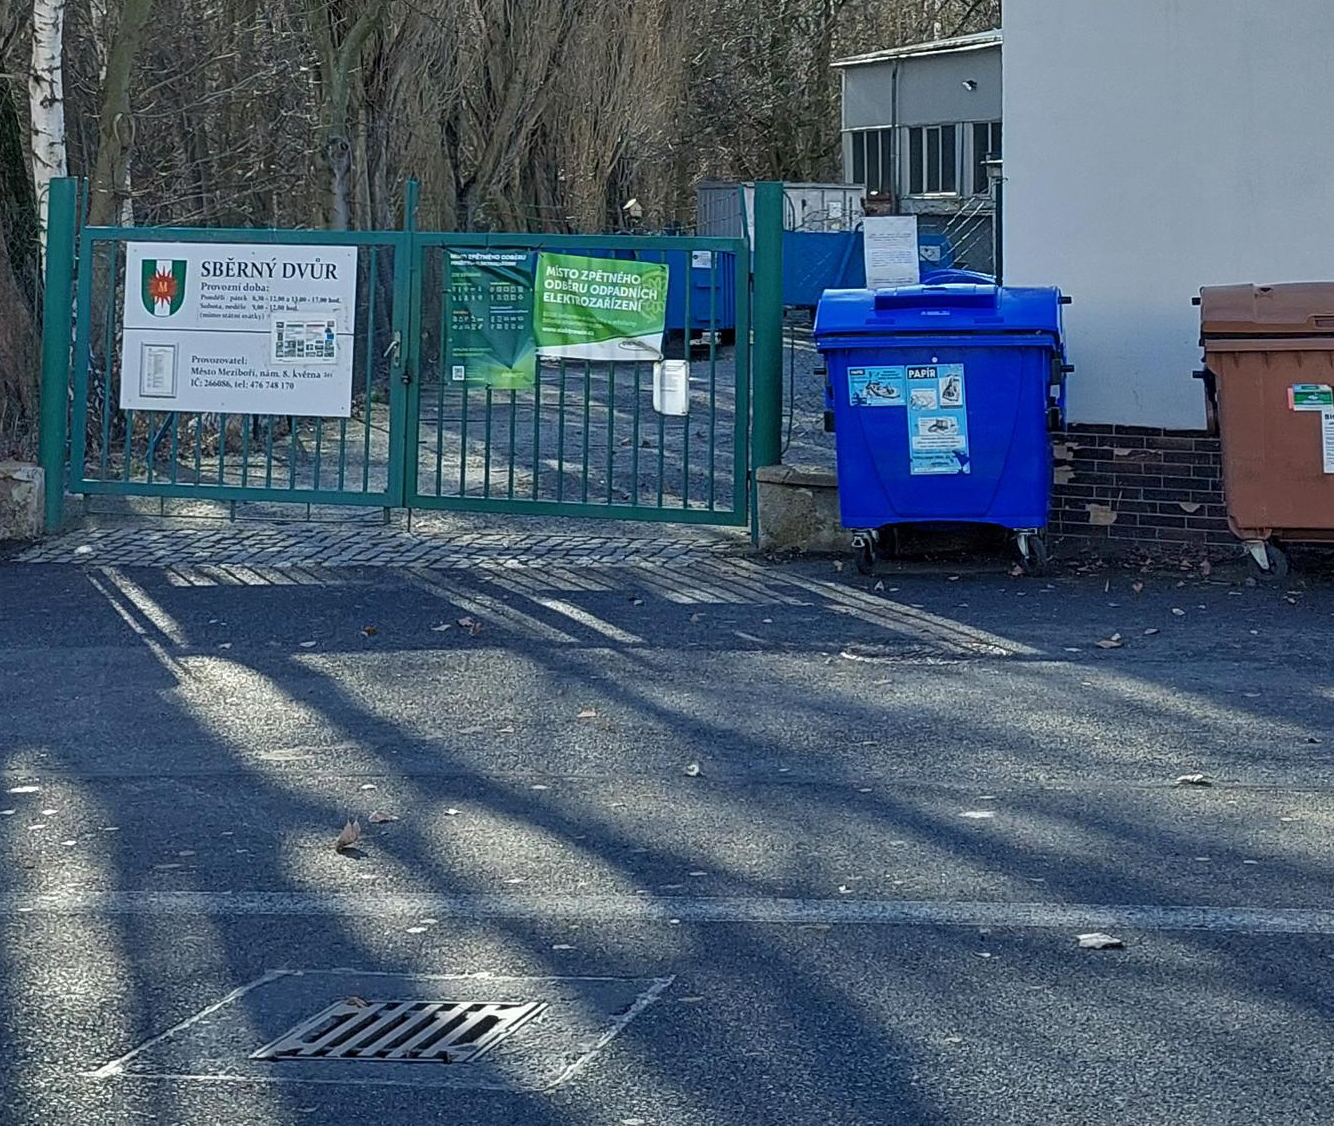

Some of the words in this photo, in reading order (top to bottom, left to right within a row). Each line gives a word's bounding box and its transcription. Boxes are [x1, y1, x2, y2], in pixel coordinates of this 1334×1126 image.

[201, 257, 277, 279] SBĚRNÝ
[282, 258, 338, 280] DVŮR
[546, 265, 579, 279] MÍSTO
[581, 269, 641, 285] ZPĚTNÉHO
[158, 281, 168, 292] M
[200, 282, 241, 292] Provozní
[243, 282, 269, 292] doba:
[544, 279, 588, 294] ODBĚRU
[590, 284, 658, 300] ODPADNÍCH
[543, 292, 644, 312] ELEKTROZAŘÍZENÍ
[191, 355, 248, 365] Provozovatel:
[191, 367, 216, 376] Město
[292, 368, 321, 379] května
[908, 367, 936, 379] PAPÍR
[234, 379, 248, 388] tel:
[249, 380, 264, 389] 476
[265, 381, 279, 389] 748
[281, 381, 294, 390] 170
